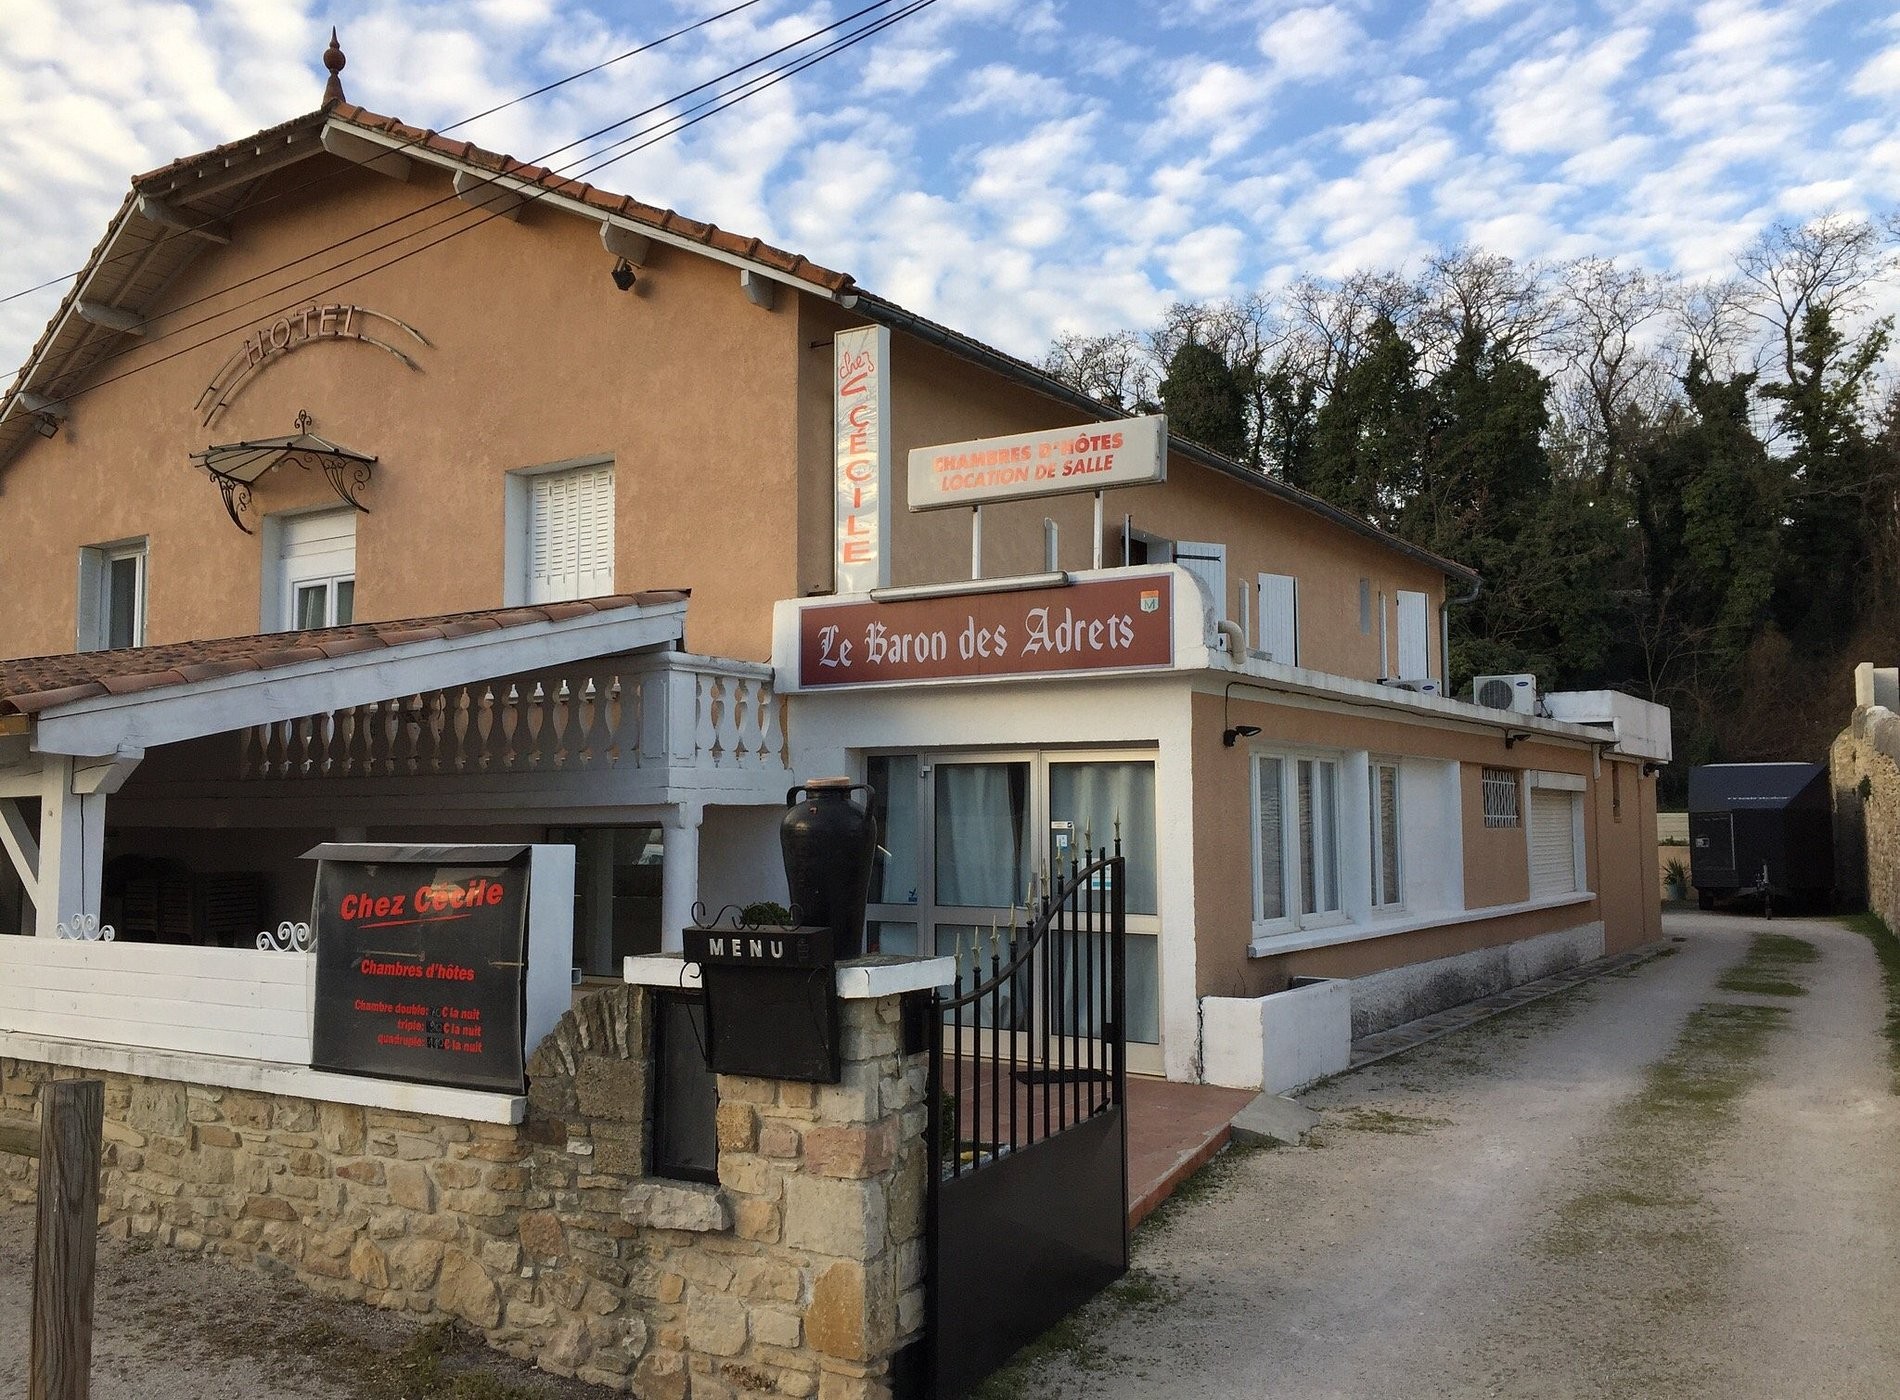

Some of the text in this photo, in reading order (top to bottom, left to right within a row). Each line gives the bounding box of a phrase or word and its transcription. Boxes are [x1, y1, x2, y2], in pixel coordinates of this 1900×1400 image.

[244, 303, 361, 367] HOTEL
[933, 433, 1124, 473] CHAMBRES D'HÔTES
[941, 455, 1113, 492] LOCATION DE SALLE
[818, 606, 1135, 668] Le Baron des Adrets
[340, 879, 504, 921] Chez Cécile
[709, 938, 784, 958] MENU
[361, 959, 475, 981] Chambres d'hôtes
[355, 999, 393, 1013] Chambre
[450, 1007, 458, 1018] la
[461, 1008, 480, 1020] nuit
[451, 1022, 460, 1035] la
[462, 1023, 481, 1036] nuit
[452, 1038, 461, 1050] la
[463, 1040, 482, 1053] nuit
